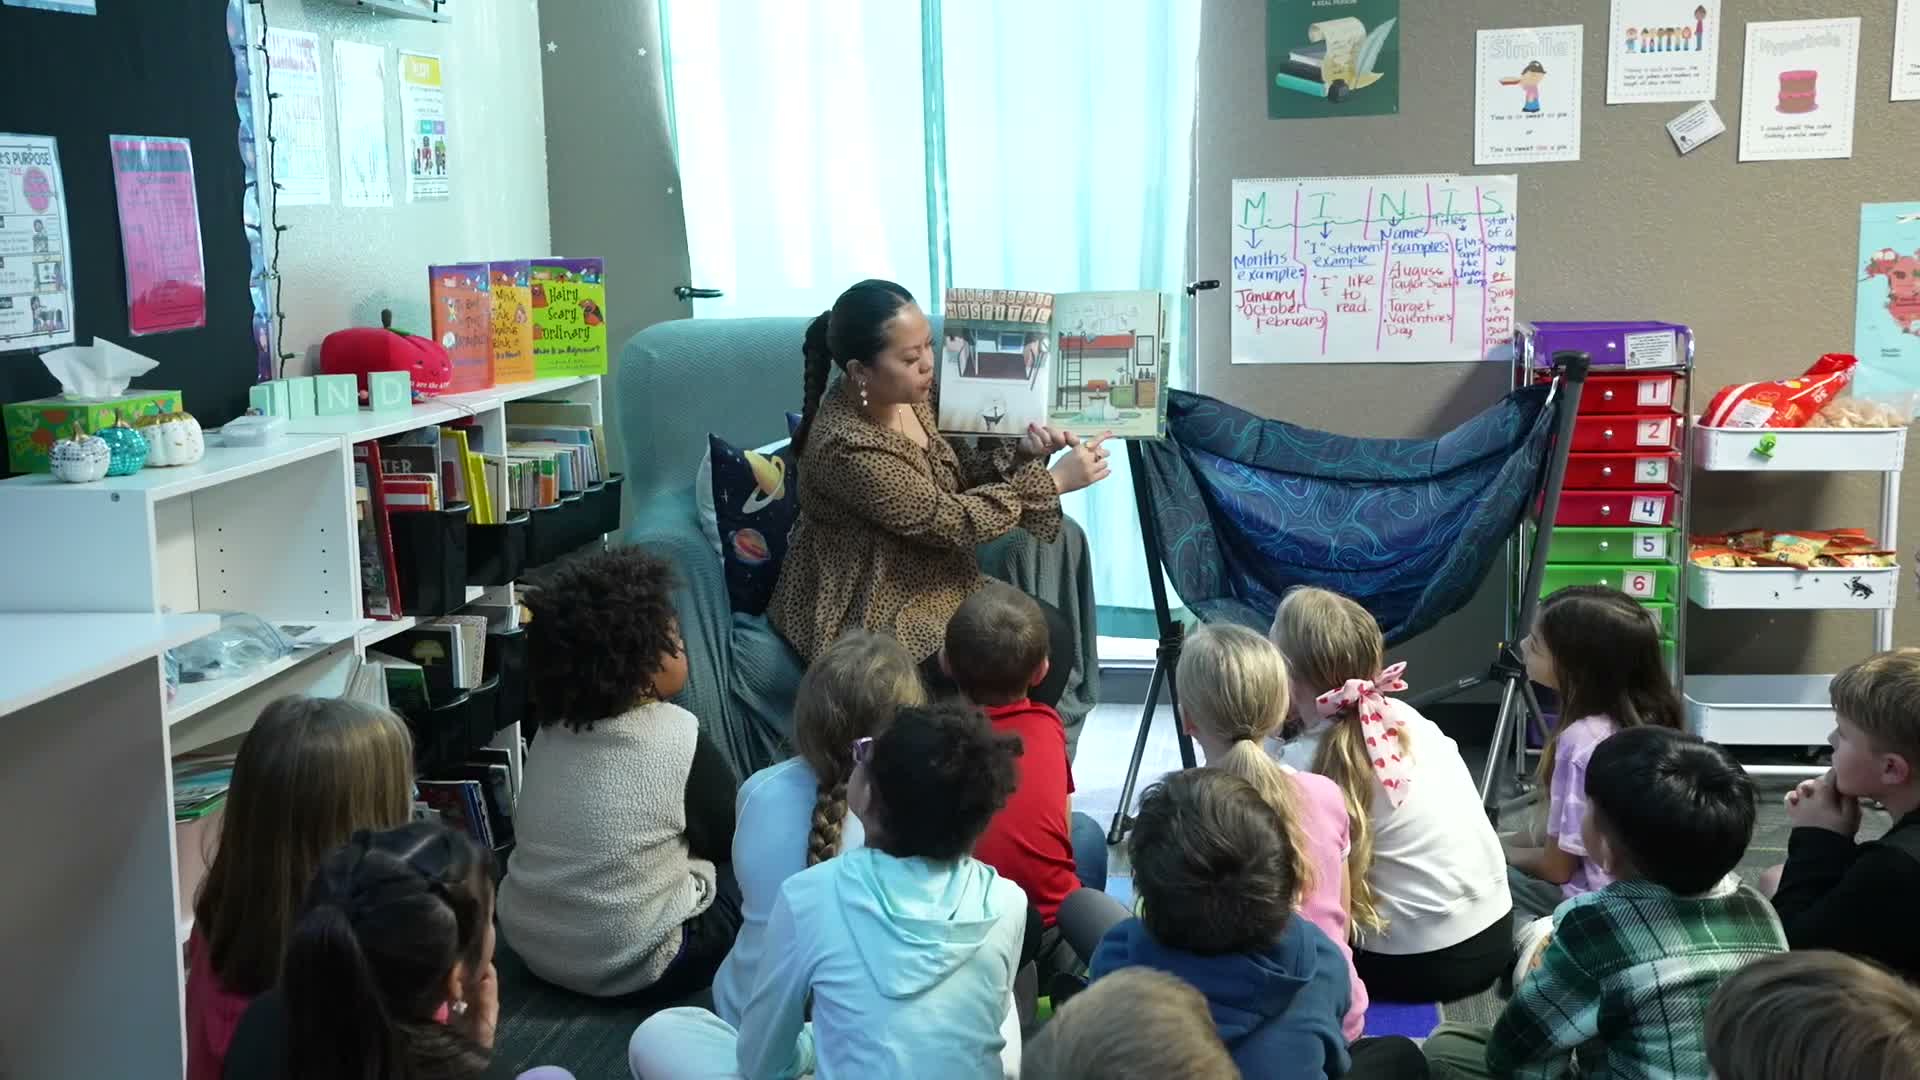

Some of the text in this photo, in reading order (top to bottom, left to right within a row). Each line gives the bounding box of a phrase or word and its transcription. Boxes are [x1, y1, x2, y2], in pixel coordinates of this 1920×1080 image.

[12, 152, 52, 166] PURPOSE
[1380, 228, 1429, 244] Names
[1233, 250, 1288, 270] Months
[1348, 274, 1376, 288] like
[1234, 288, 1296, 309] January
[1341, 288, 1361, 301] to
[946, 304, 1052, 323] HOSPITAL
[1243, 303, 1305, 317] October
[1387, 298, 1436, 315] Target
[1256, 313, 1328, 330] February
[1387, 324, 1413, 340] Day
[1652, 383, 1658, 399] 1
[1647, 422, 1659, 439] 2
[1646, 461, 1659, 477] 3
[1641, 500, 1655, 517] 4
[1642, 536, 1656, 553] 5
[1633, 575, 1646, 592] 6
